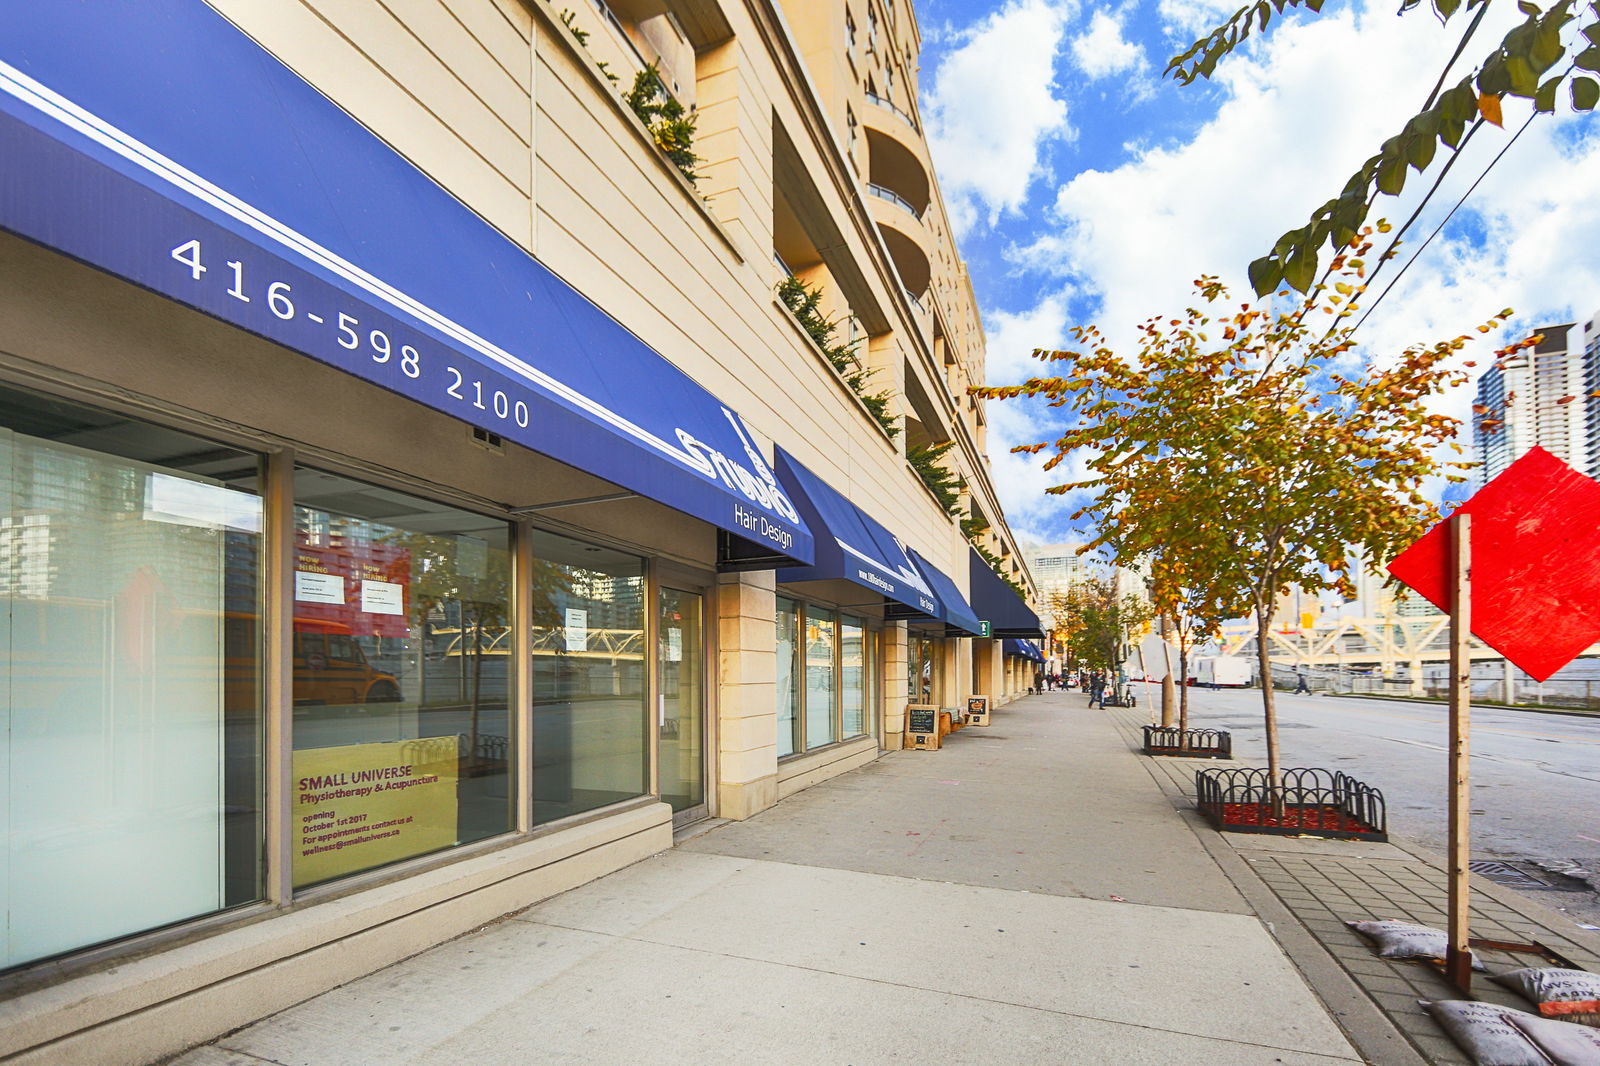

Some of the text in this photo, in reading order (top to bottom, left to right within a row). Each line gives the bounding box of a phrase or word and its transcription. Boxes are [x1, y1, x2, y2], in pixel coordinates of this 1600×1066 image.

[171, 239, 530, 428] 416-598 2100
[735, 504, 792, 549] Hair Design
[299, 765, 412, 791] SMALL UNIVERSE
[300, 776, 438, 804] Physiotherapy & Acupuncture
[303, 811, 335, 823] opening
[303, 814, 367, 834] October 1st 2017
[303, 837, 316, 845] For
[318, 825, 370, 842] appointments
[372, 819, 396, 830] contact
[303, 829, 400, 856] wellness@smalluniverse.ca
